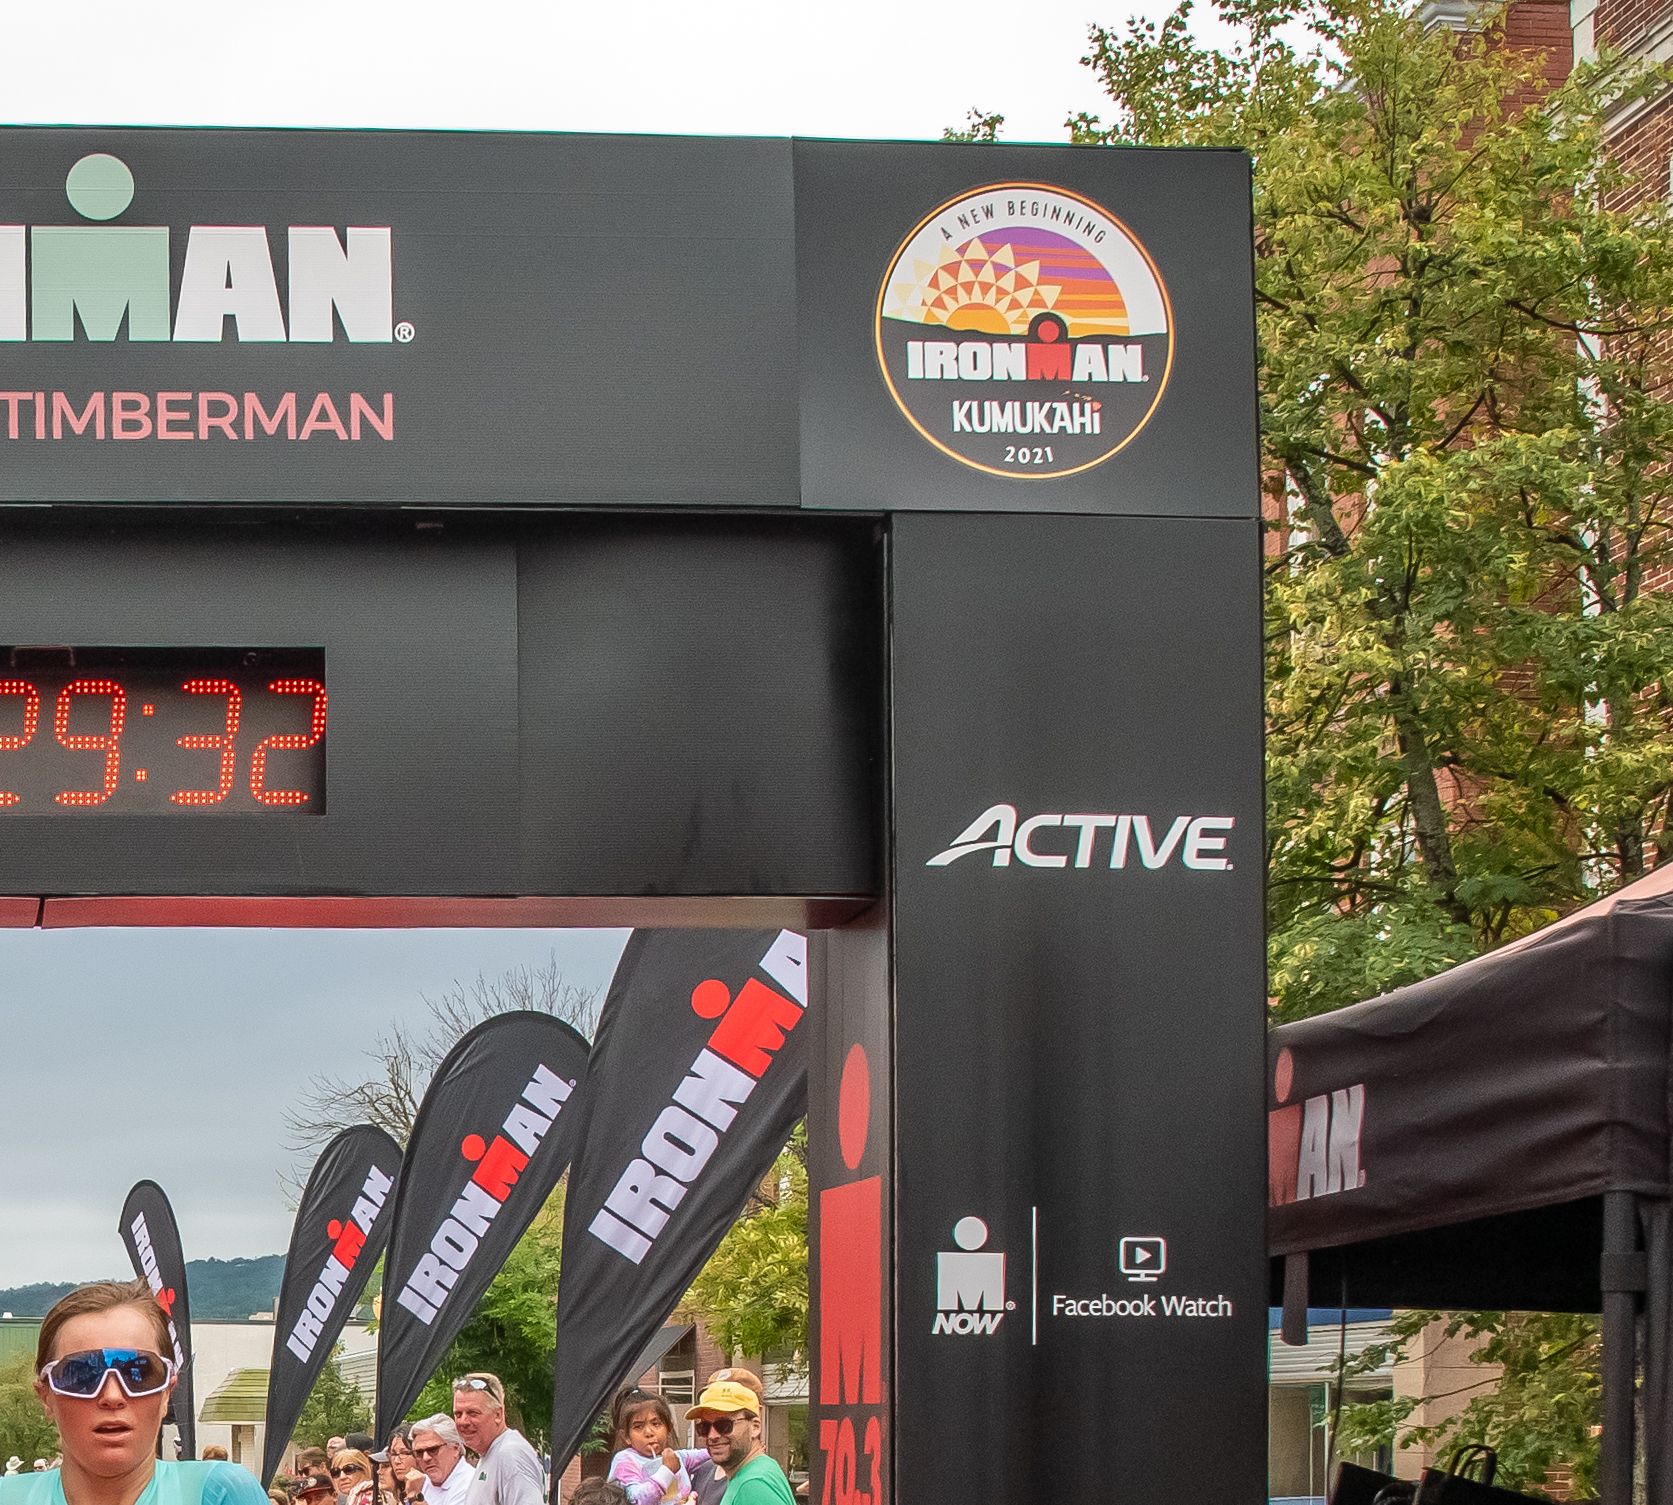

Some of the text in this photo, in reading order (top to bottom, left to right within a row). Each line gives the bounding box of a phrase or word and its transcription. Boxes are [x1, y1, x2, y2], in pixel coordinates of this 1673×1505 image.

[940, 200, 1108, 245] A NEW BEGINNING
[906, 320, 1144, 383] IRONMAN
[1004, 446, 1055, 464] 2021
[925, 803, 1236, 871] ACTIVE
[396, 1063, 576, 1325] IRONMAN
[287, 1165, 394, 1363] IRONMAN
[932, 1313, 1004, 1334] NOW
[1052, 1294, 1232, 1318] Facebook Watch
